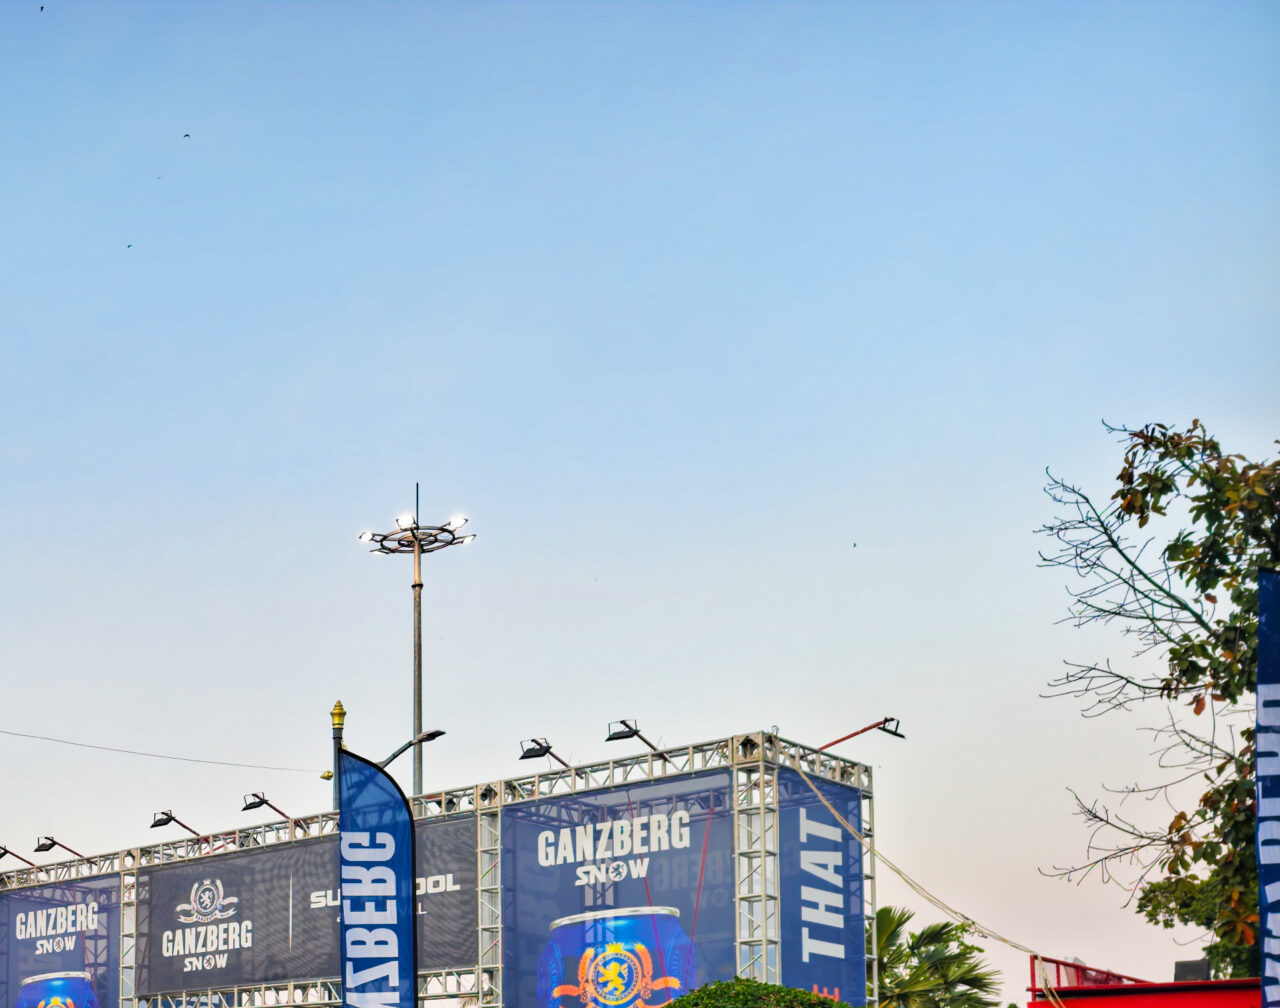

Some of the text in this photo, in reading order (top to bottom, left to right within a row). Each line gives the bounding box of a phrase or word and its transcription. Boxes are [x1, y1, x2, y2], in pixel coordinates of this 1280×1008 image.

[537, 809, 691, 867] GANZBERG
[799, 806, 846, 963] THAT
[16, 901, 98, 940] GANZBERG
[161, 920, 253, 957] GANZBERG
